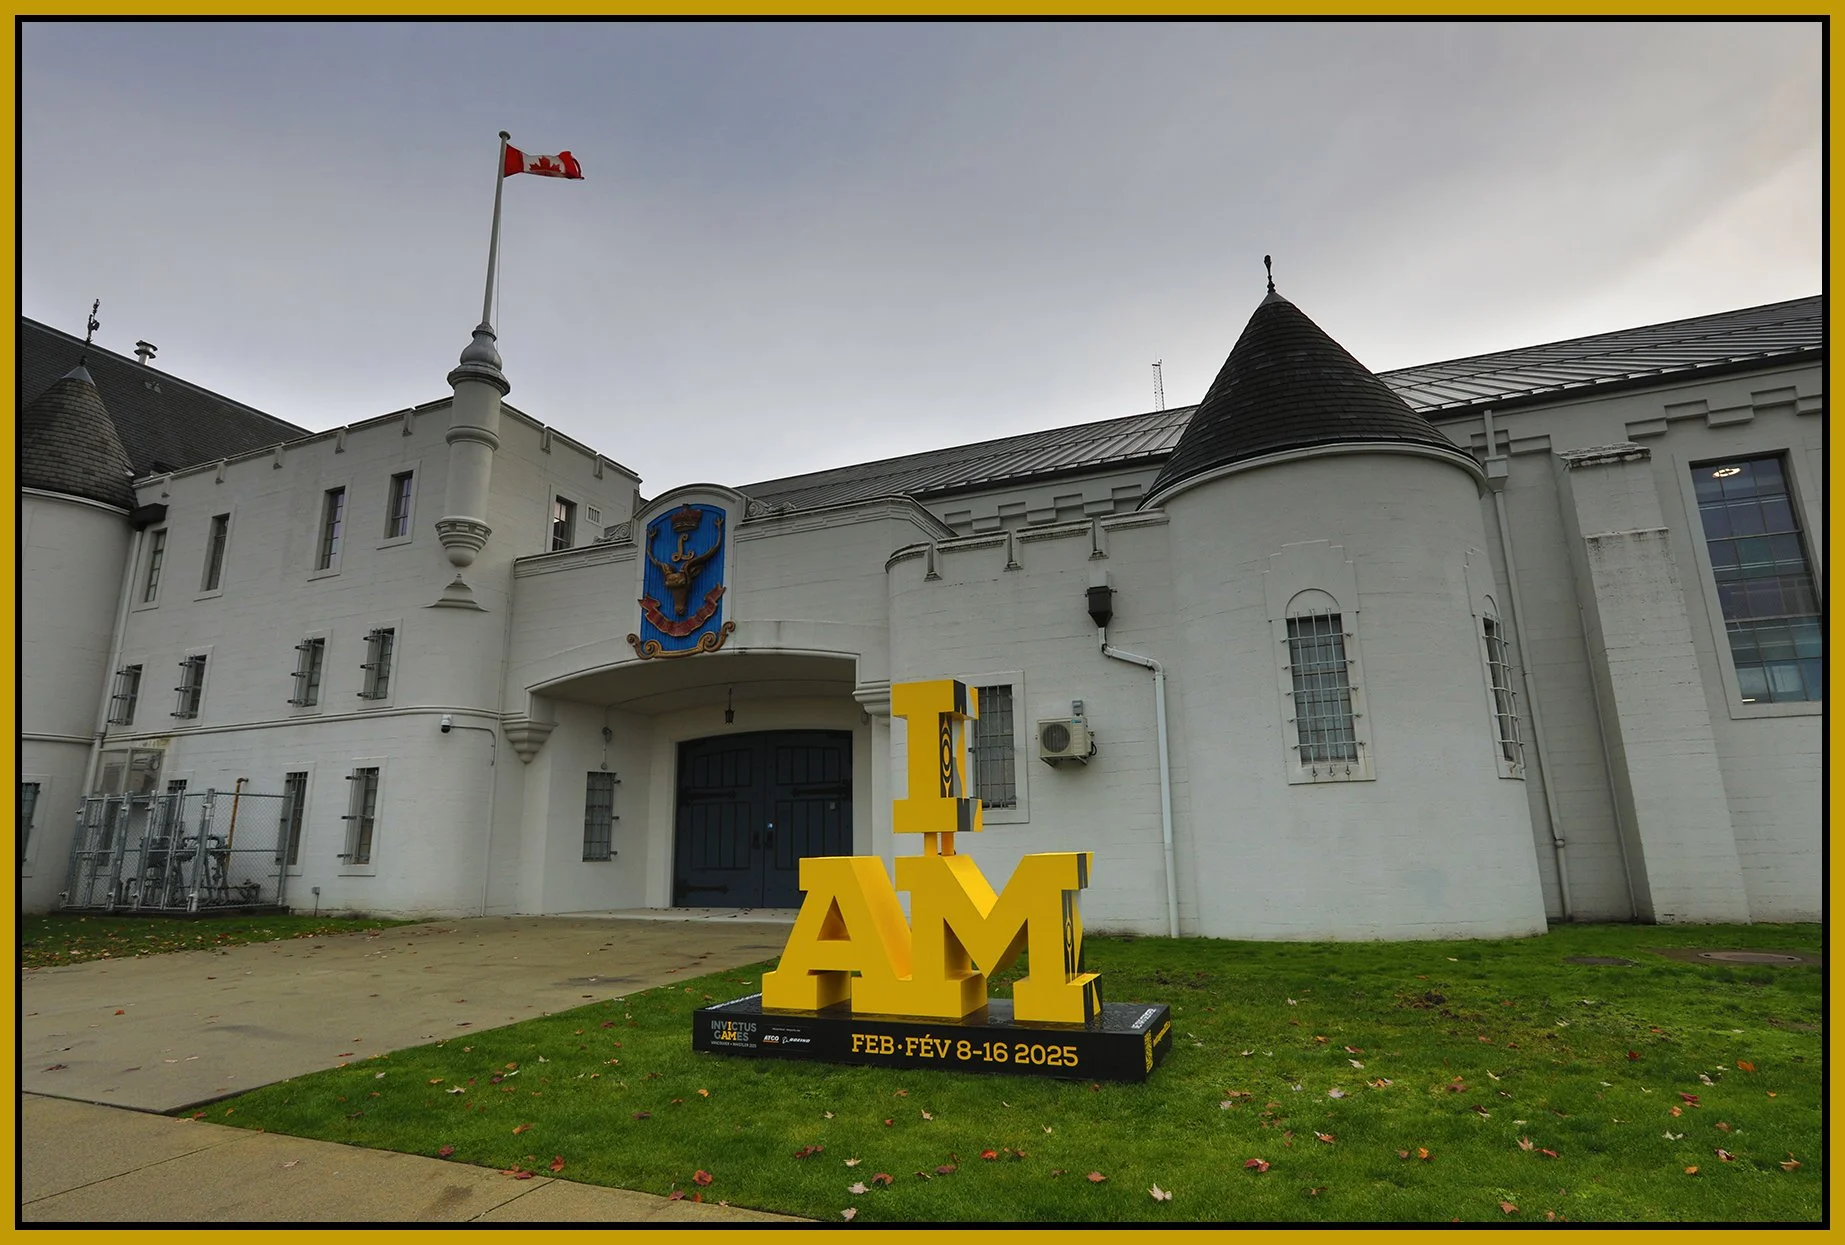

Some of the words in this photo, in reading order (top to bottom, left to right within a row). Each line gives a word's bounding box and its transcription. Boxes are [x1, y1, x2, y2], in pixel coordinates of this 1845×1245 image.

[890, 679, 983, 833] I
[762, 852, 1102, 1023] AM
[710, 1020, 757, 1033] INVICTUS
[713, 1030, 749, 1042] GAMES
[956, 1040, 1009, 1063] 8-16
[1014, 1043, 1079, 1067] 2025
